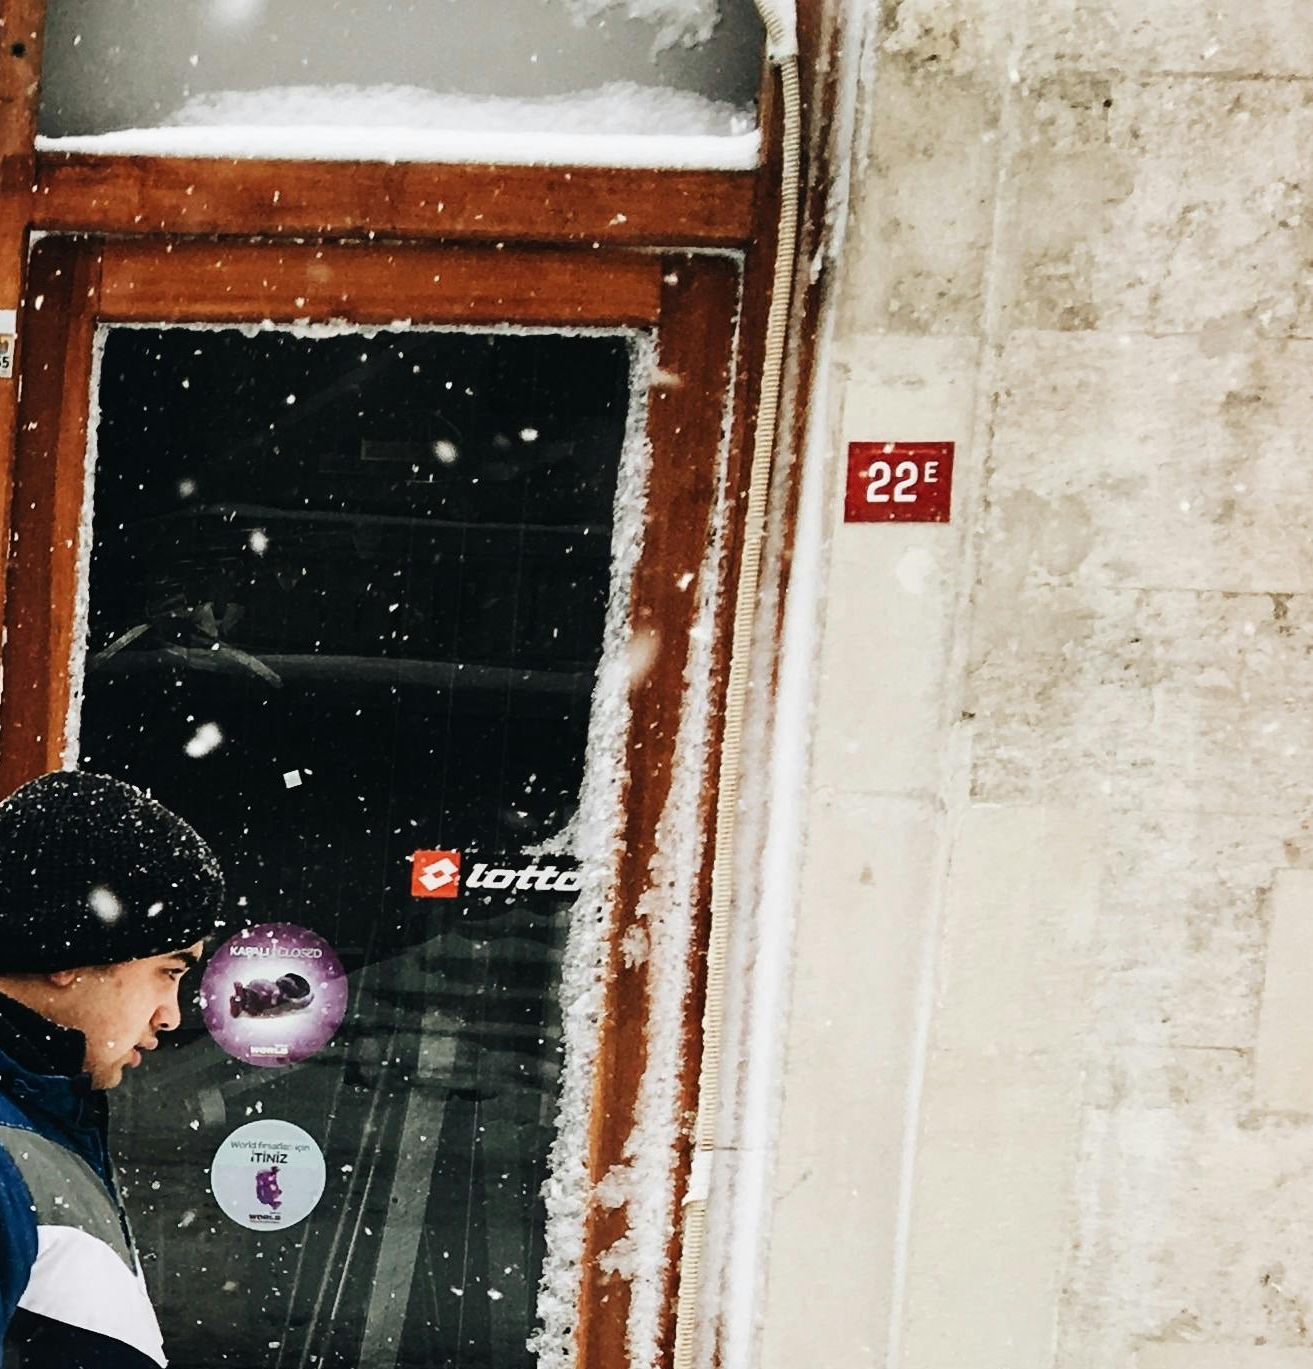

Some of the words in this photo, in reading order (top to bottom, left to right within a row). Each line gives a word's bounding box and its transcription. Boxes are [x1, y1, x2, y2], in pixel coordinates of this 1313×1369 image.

[465, 863, 583, 892] lotto
[229, 945, 270, 958] KAPALI
[277, 946, 323, 959] CLOSED
